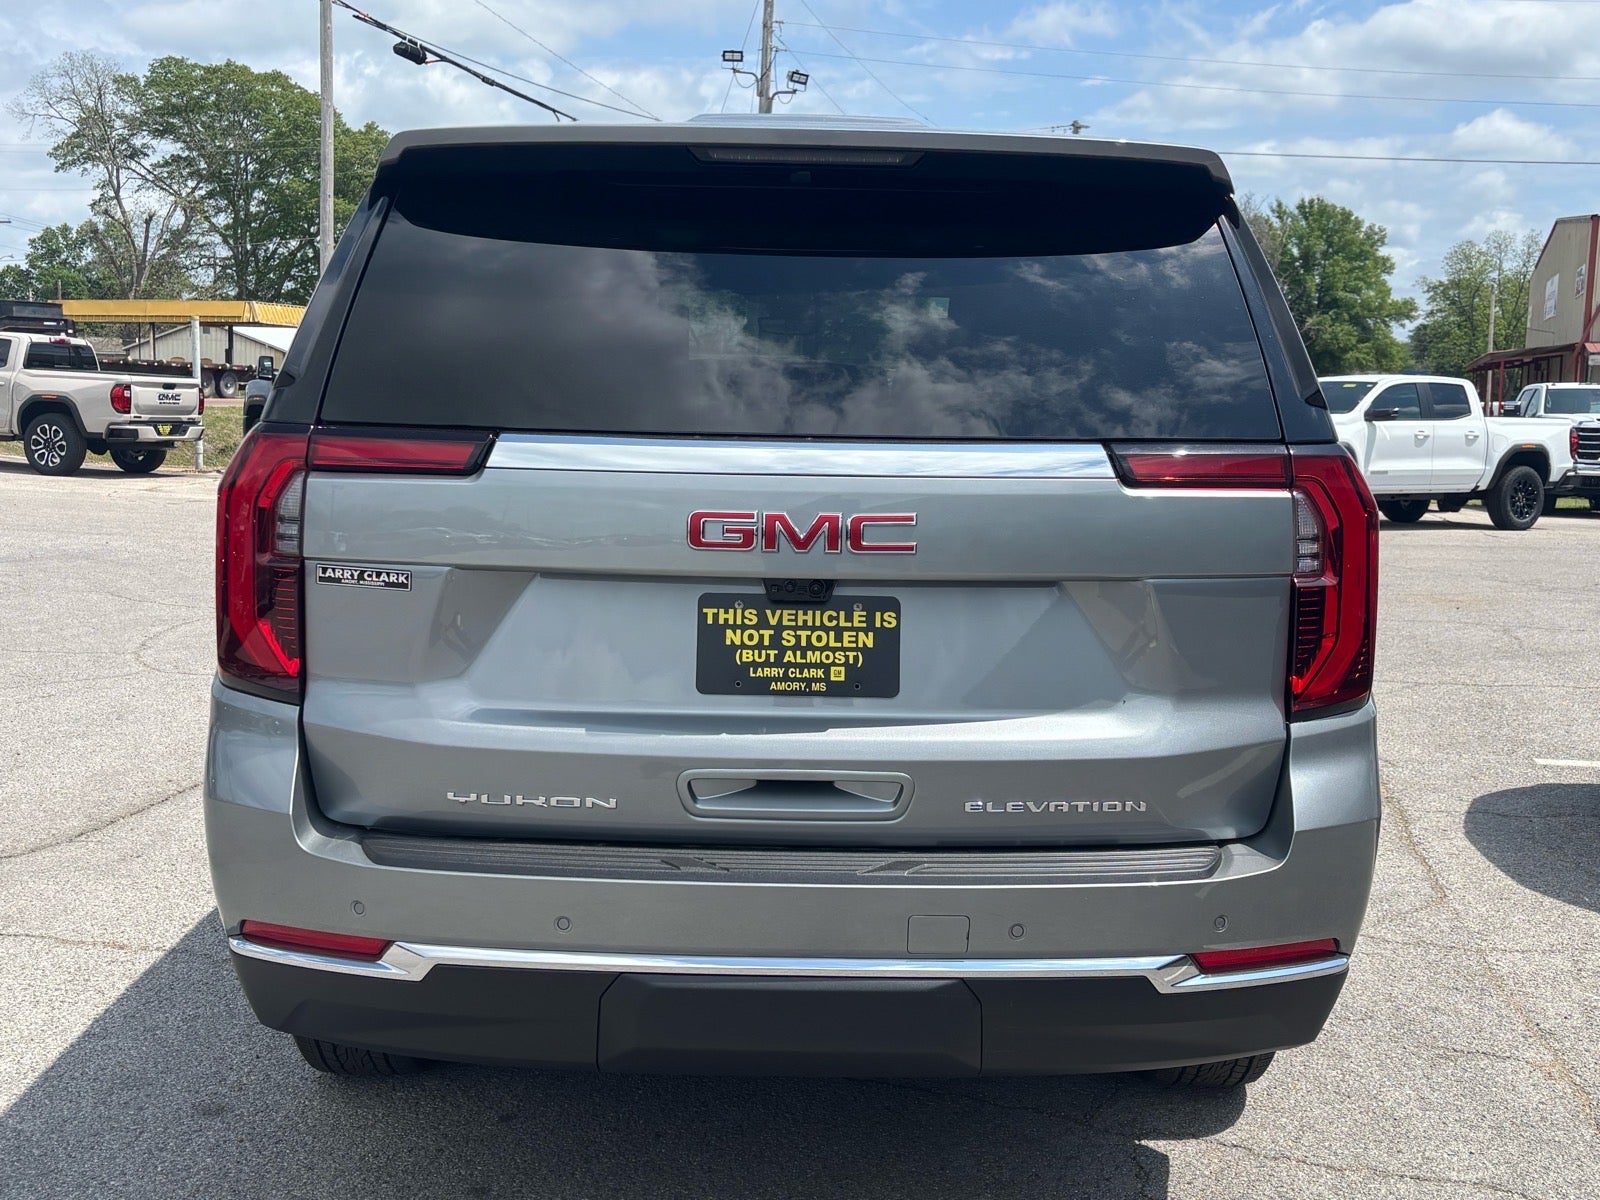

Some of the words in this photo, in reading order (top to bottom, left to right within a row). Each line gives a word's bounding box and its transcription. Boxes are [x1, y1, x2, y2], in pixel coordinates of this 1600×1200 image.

[158, 393, 181, 401] GMC
[687, 510, 917, 554] GMC
[319, 567, 360, 580] LARRY
[363, 571, 409, 584] CLARK
[702, 608, 758, 625] THIS
[765, 609, 867, 628] VEHICLE
[875, 611, 897, 628] IS
[725, 629, 774, 646] NOT
[781, 631, 874, 648] STOLEN
[735, 649, 778, 665] (BUT
[783, 651, 863, 667] ALMOST)
[749, 667, 785, 678] LARRY
[788, 668, 825, 679] CLARK
[769, 682, 810, 692] AMORY,
[811, 682, 827, 691] MS
[447, 792, 617, 809] YUKON
[964, 801, 1147, 813] ELEVATION
